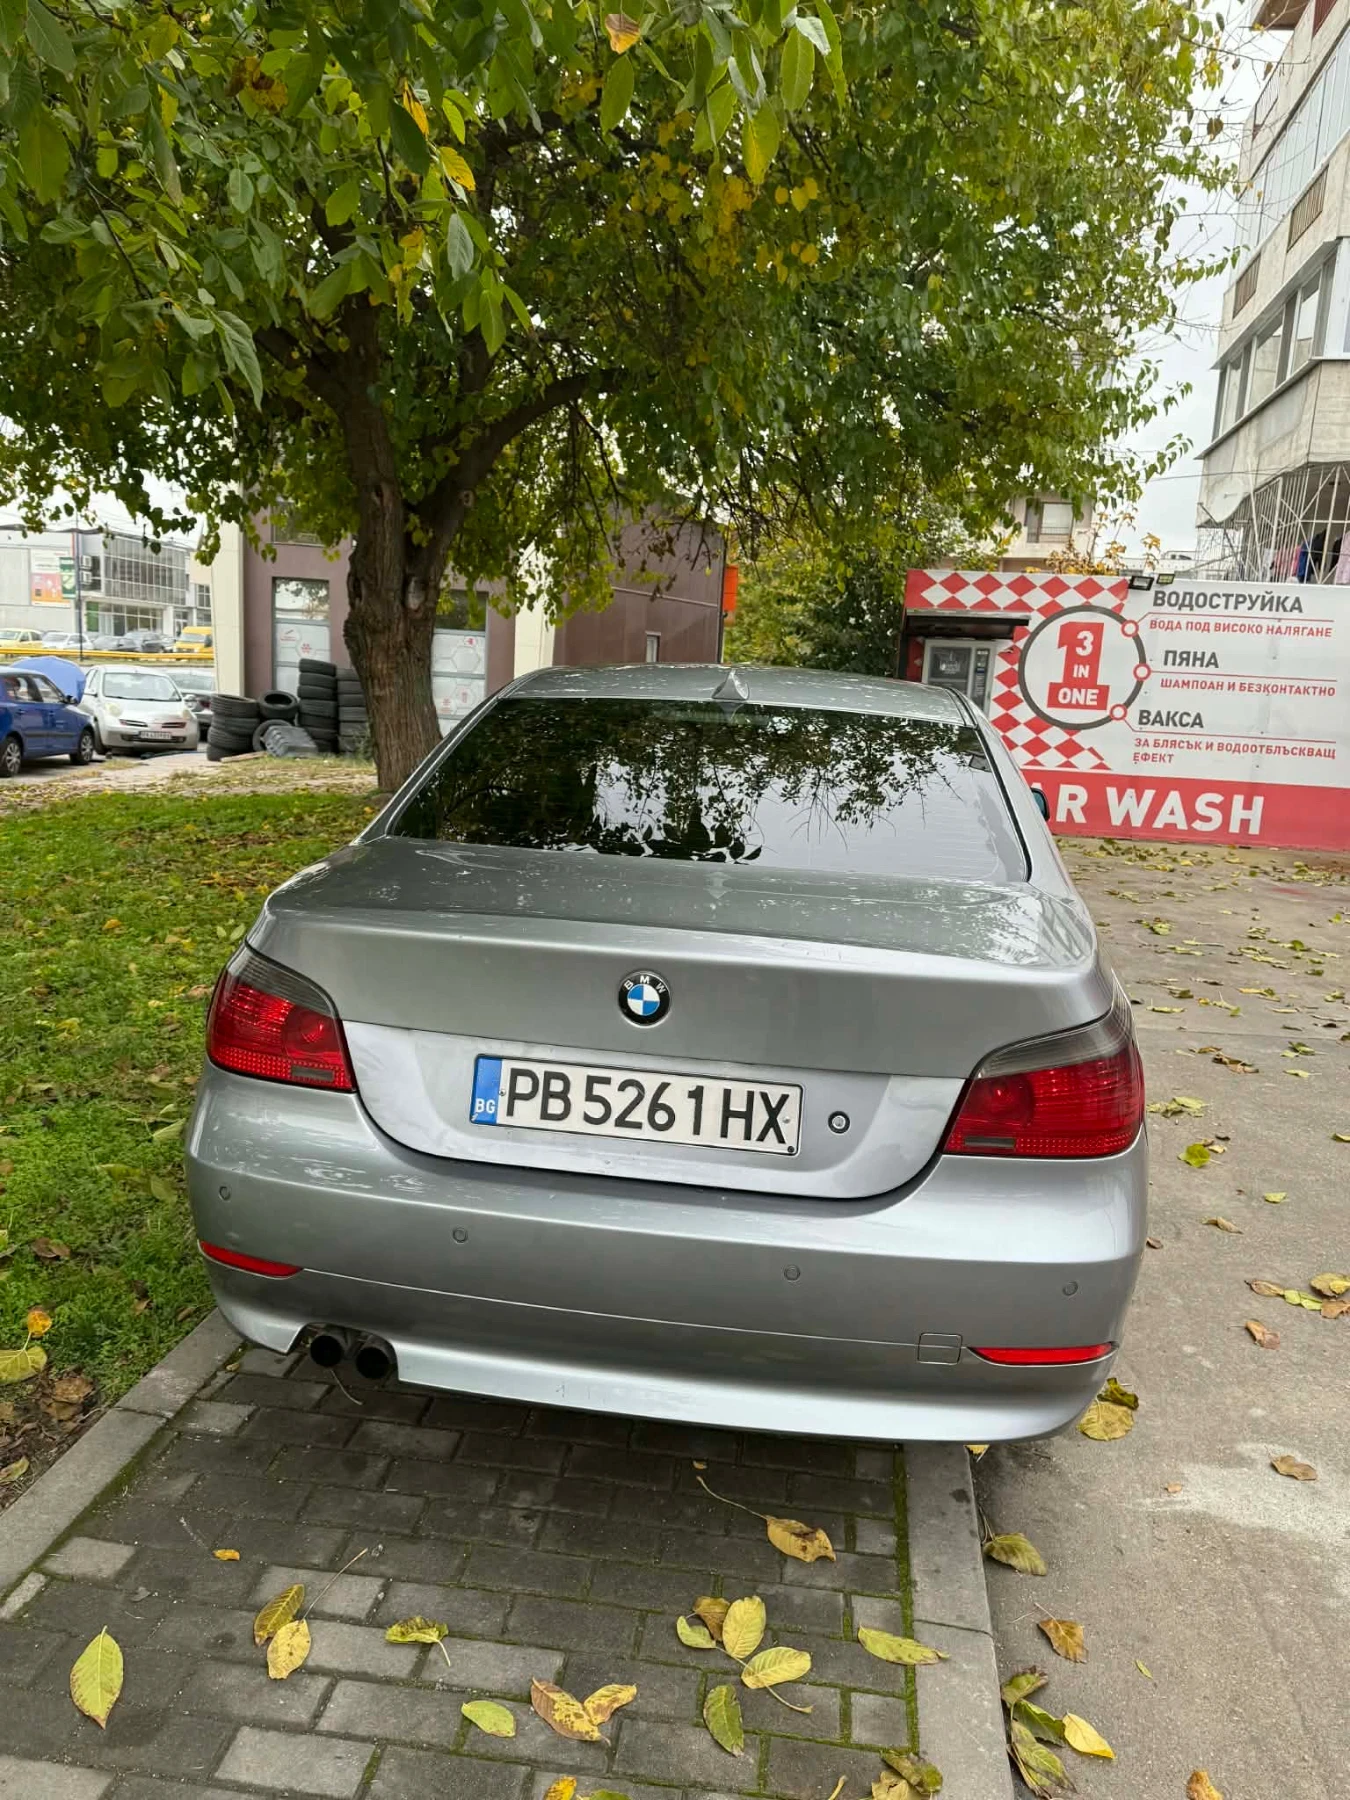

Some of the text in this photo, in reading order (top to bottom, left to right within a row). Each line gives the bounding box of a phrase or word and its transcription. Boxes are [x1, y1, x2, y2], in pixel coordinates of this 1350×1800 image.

[1152, 590, 1303, 613] ВОДОСТРУЙКА
[1150, 619, 1333, 638] ВОДА ПОД ВИСОКО НАЛЯГАНЕ
[1075, 630, 1094, 657] 3
[1163, 650, 1219, 669] ПЯНА
[1072, 664, 1090, 679] IN
[1057, 687, 1100, 706] ONE
[1160, 678, 1336, 697] ШАМПОАН И БЕЗКОНТАКТНО
[1138, 709, 1204, 729] ВАКСА
[1132, 752, 1174, 764] ЕФЕКТ
[1134, 738, 1336, 760] ЗА БЛЯСЪК И ВОДООТБЛЪСКВАЩ
[1106, 786, 1264, 836] WASH
[623, 975, 666, 994] BMW
[474, 1097, 496, 1115] BG
[583, 1074, 704, 1136] 5261
